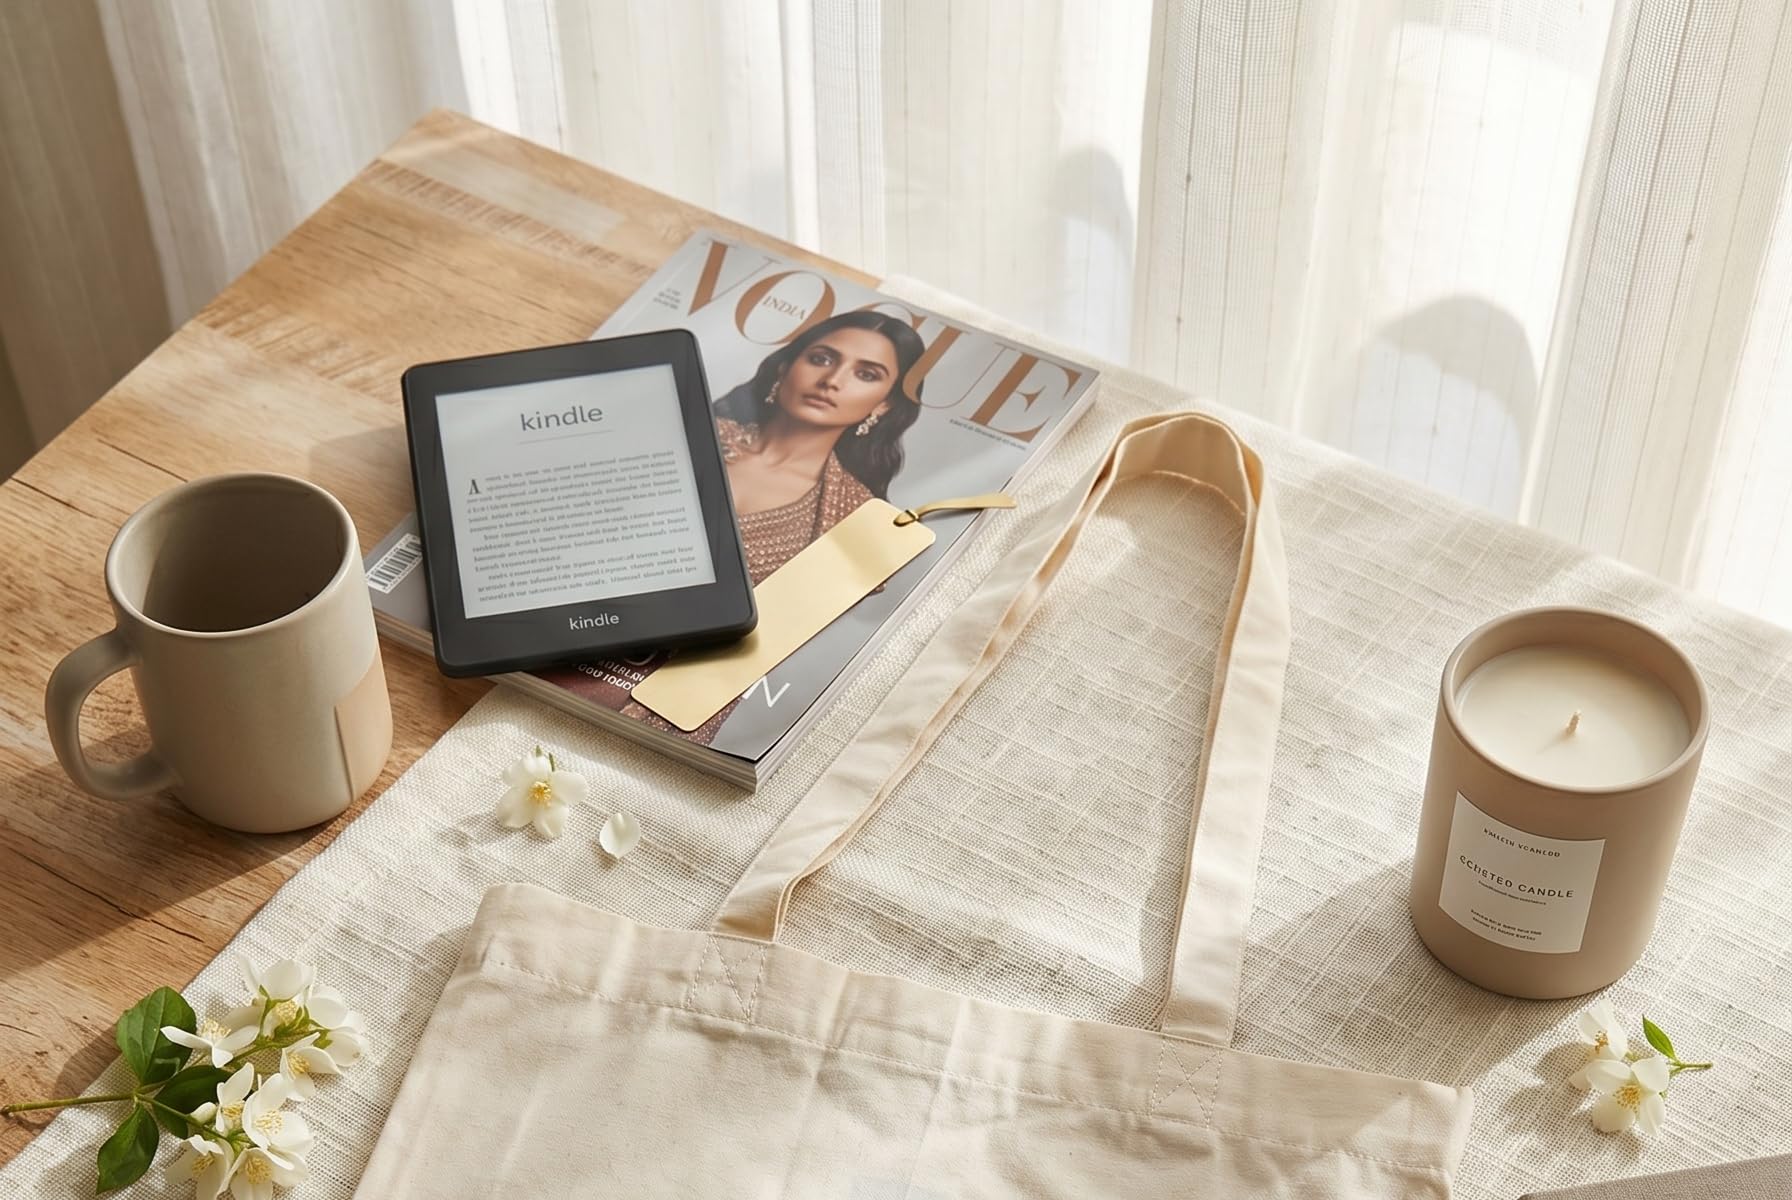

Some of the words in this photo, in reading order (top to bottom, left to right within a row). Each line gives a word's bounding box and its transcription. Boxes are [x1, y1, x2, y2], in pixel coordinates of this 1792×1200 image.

[762, 295, 807, 321] INDIA
[520, 405, 604, 432] kindle
[569, 612, 620, 631] kindle
[1518, 883, 1575, 898] CANDLE
